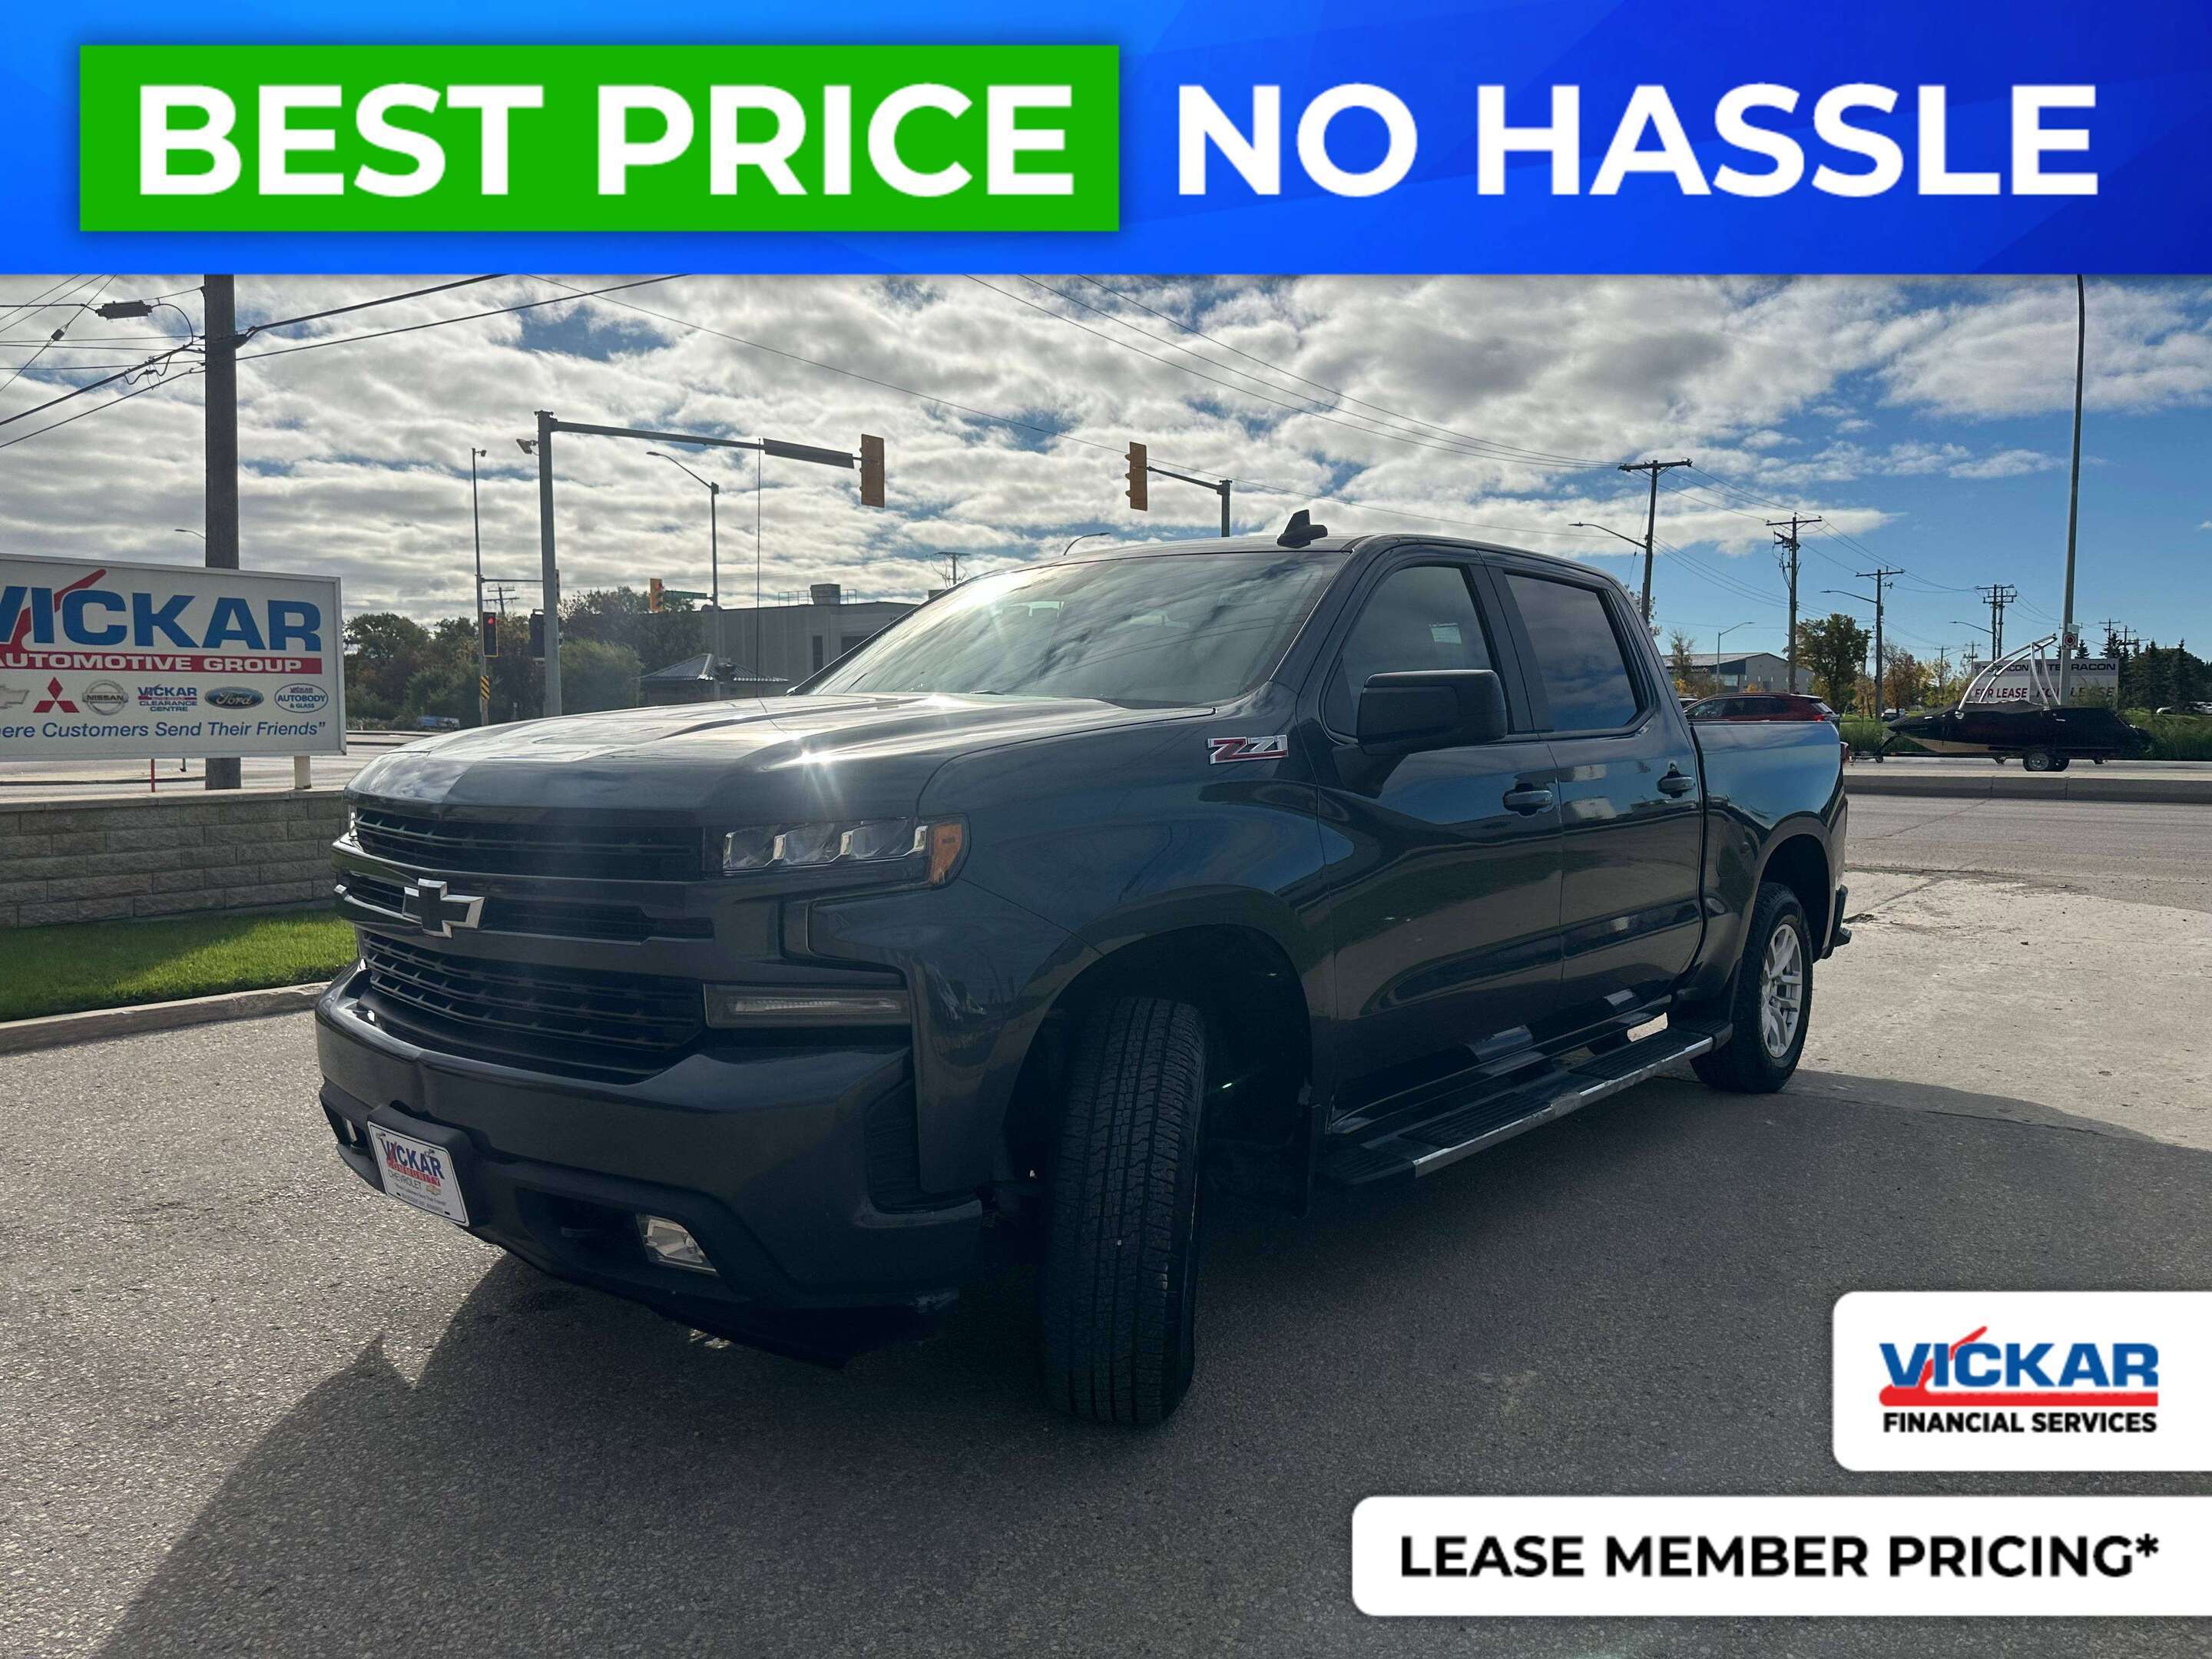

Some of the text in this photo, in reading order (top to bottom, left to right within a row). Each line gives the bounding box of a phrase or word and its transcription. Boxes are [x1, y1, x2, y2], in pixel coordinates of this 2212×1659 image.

[0, 653, 302, 672] UTOMOTIVE GROUP
[138, 687, 197, 697] VICKAR
[216, 693, 253, 705] Ford
[1996, 688, 2028, 698] LEASE
[43, 722, 148, 737] Customers
[154, 721, 201, 737] Send
[208, 721, 252, 736] Their
[1208, 734, 1289, 764] Z71
[380, 1137, 445, 1179] VICKAR
[387, 1161, 442, 1187] COMMUNITY
[387, 1168, 422, 1190] CHEVROLET
